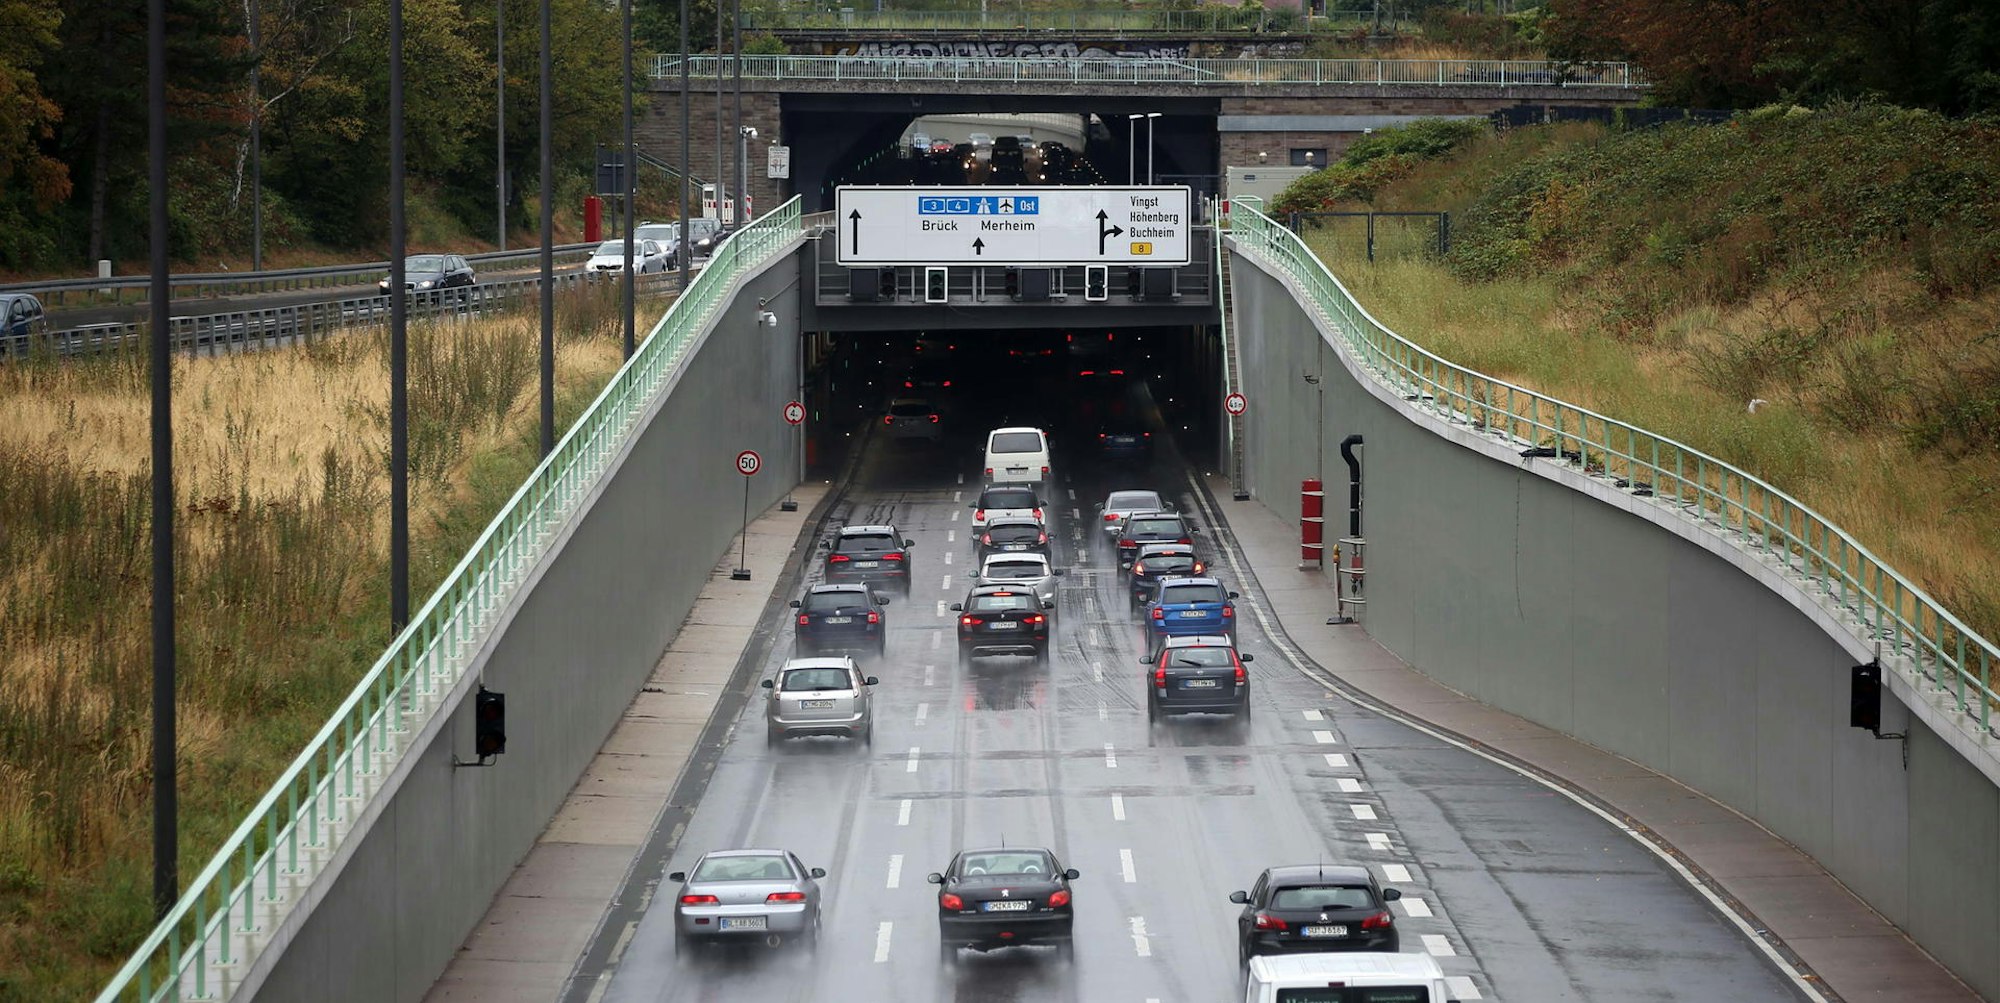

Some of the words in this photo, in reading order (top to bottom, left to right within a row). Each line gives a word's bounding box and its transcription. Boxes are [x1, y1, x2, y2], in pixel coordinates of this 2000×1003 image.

[931, 201, 937, 210] 3
[954, 201, 961, 210] 4
[1020, 200, 1035, 212] Ost
[1130, 196, 1159, 208] Vingst
[1130, 211, 1179, 225] Höhenberg
[922, 219, 958, 231] Brück
[981, 219, 1035, 231] Merheim
[1130, 227, 1175, 238] Buchheim
[1138, 244, 1145, 253] 8
[742, 457, 756, 469] 50
